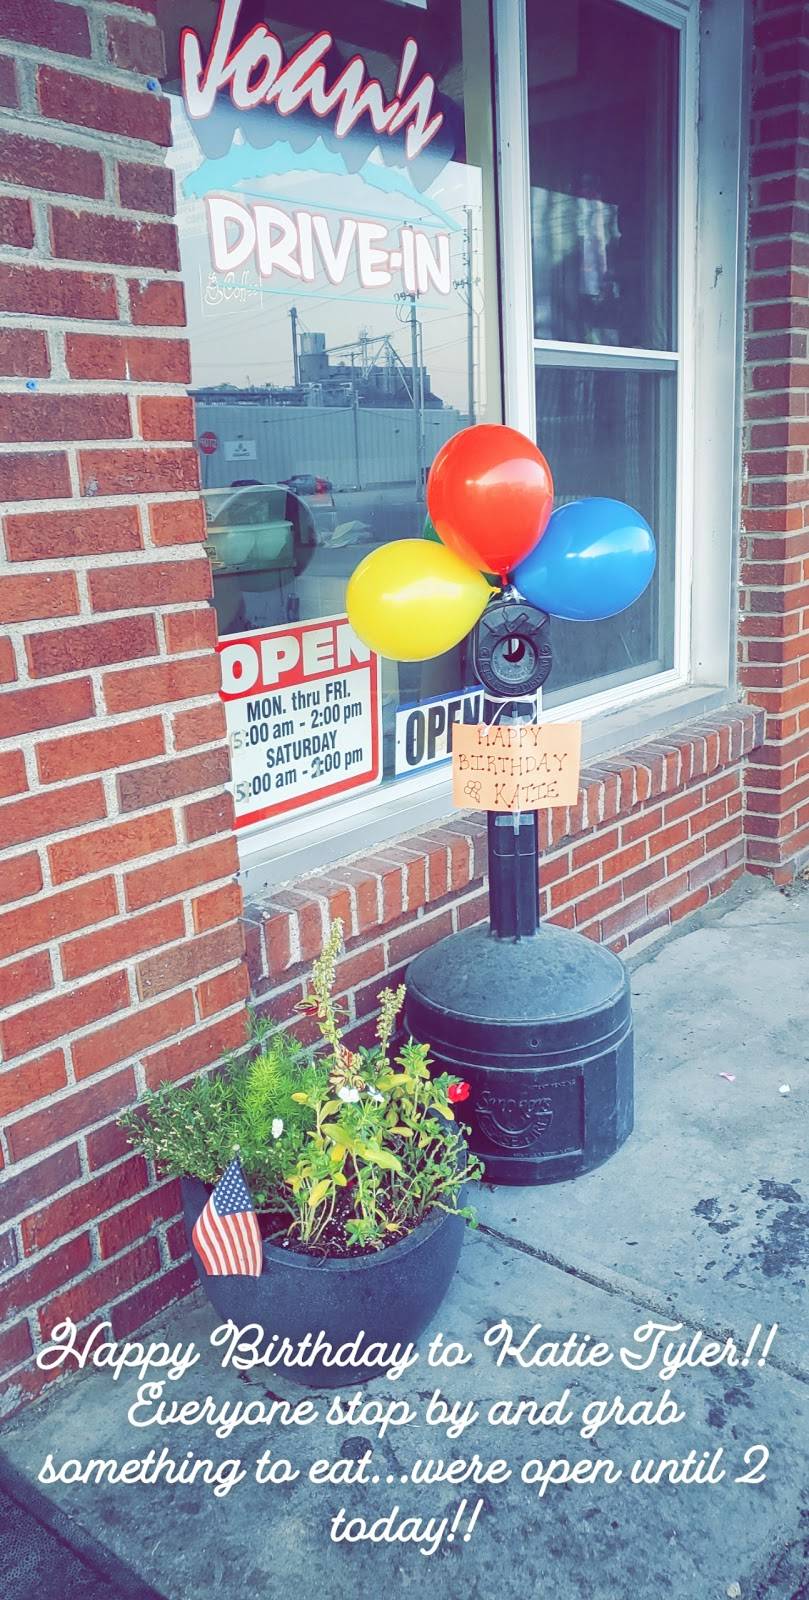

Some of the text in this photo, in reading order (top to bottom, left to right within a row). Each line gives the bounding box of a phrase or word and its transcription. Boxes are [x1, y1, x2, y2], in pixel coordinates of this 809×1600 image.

[180, 0, 445, 160] Joan's
[204, 195, 454, 294] DRIVE-IN
[219, 623, 371, 695] OPEN
[246, 679, 351, 722] MON. thru FRI.
[232, 722, 269, 750] 5:00
[272, 719, 294, 740] am
[310, 703, 340, 729] 2:00
[343, 701, 363, 720] pm
[477, 726, 542, 748] HAPPY
[266, 729, 338, 769] SATURDAY
[458, 752, 568, 776] BIRTHDAY
[235, 774, 271, 803] 5:00
[275, 768, 297, 789] am
[344, 747, 363, 770] pm
[494, 780, 560, 808] KATIE
